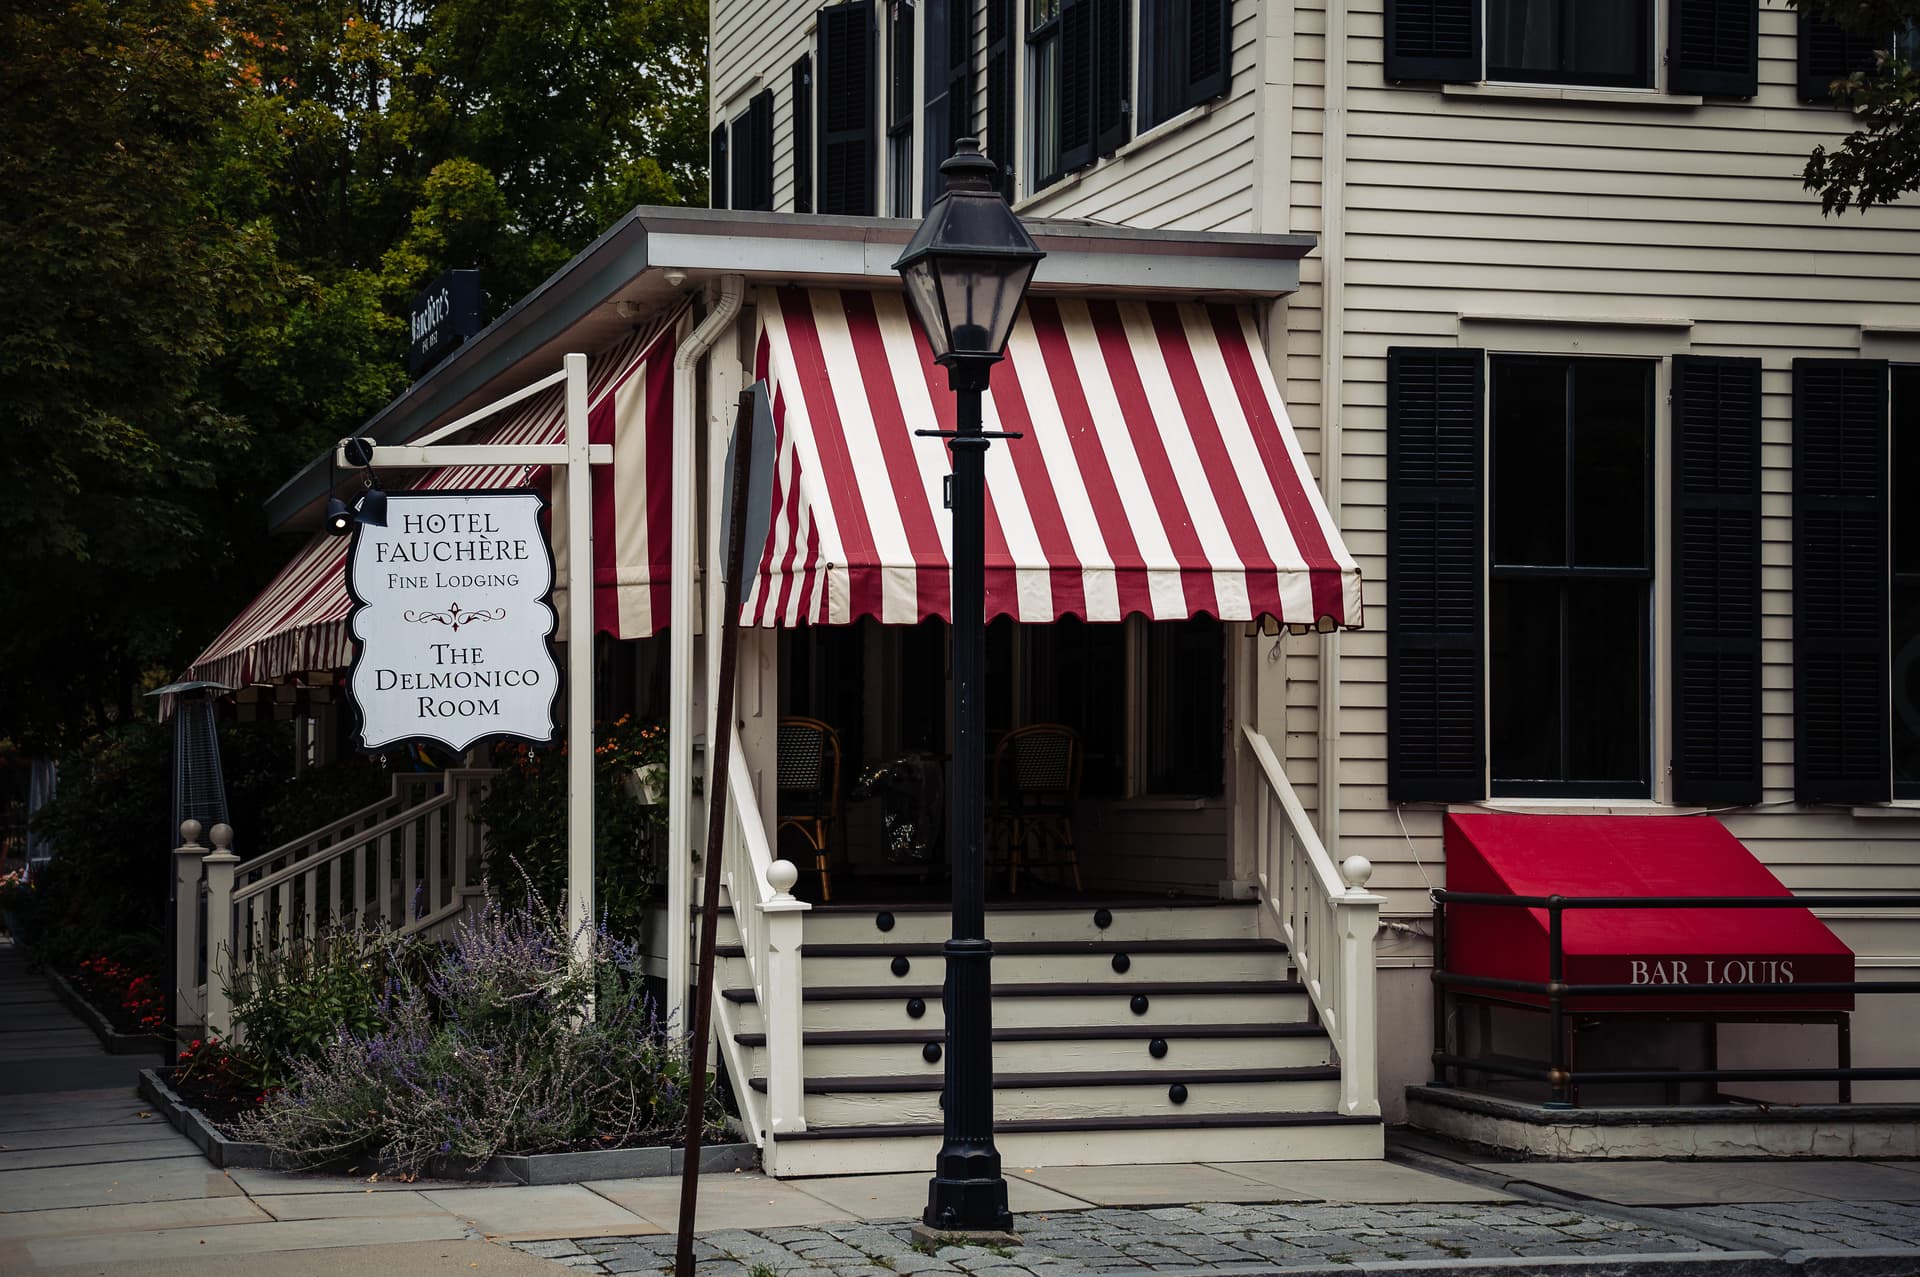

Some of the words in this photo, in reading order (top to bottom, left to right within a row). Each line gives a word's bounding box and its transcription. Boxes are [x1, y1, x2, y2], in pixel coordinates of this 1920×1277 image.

[402, 513, 500, 535] HOTEL
[375, 535, 529, 563] FAUCHÈRE
[386, 573, 429, 589] FINE
[435, 572, 520, 588] LODGING
[429, 643, 485, 665] THE
[375, 669, 540, 691] DELMONICO
[417, 696, 501, 718] ROOM
[1631, 960, 1689, 984] BAR
[1704, 960, 1795, 984] LOUIS
